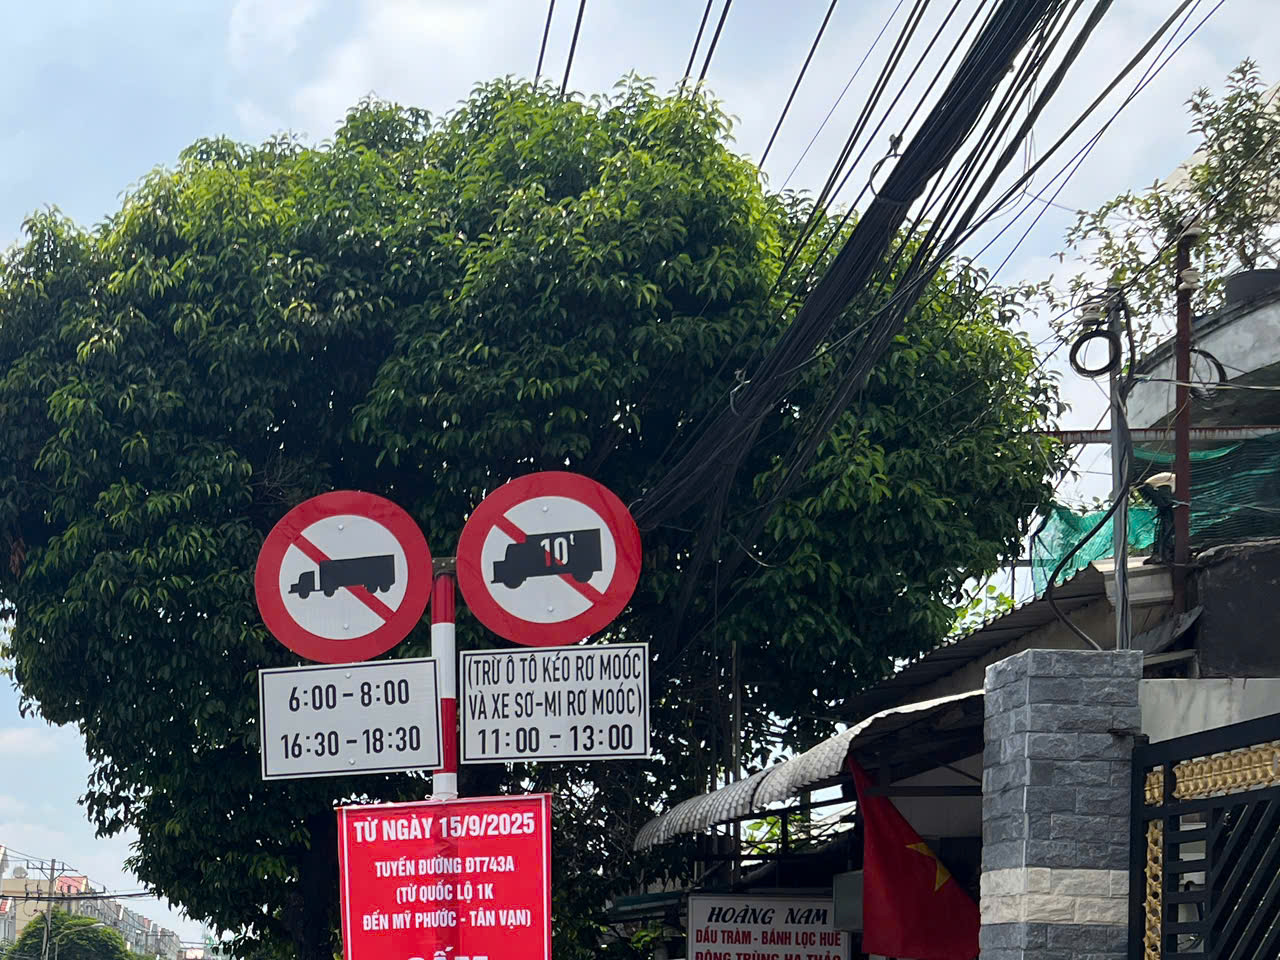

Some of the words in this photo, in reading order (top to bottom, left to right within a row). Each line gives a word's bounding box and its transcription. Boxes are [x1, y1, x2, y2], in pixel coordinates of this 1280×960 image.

[468, 656, 501, 689] (TRỪ
[506, 655, 515, 684] Ô
[520, 654, 537, 683] TÔ
[543, 651, 570, 682] KÉO
[576, 654, 596, 681] RƠ
[600, 649, 641, 680] MOÓC
[289, 684, 337, 712] 6:00
[360, 679, 410, 707] 8:00
[469, 690, 487, 720] VÀ
[492, 693, 509, 719] XE
[568, 689, 587, 716] RƠ
[592, 682, 642, 717] MOÓC)
[280, 730, 340, 759] 16:30
[363, 725, 420, 754] 18:30
[478, 727, 539, 755] 11:00
[570, 724, 632, 751] 13:00
[354, 817, 378, 842] TỪ
[382, 814, 433, 841] NGÀY
[439, 812, 534, 838] 15/9/2025
[375, 856, 415, 877] TUYẾN
[419, 854, 462, 875] ĐƯỜNG
[466, 856, 515, 873] ĐT743A
[396, 883, 417, 904] (TỪ
[420, 880, 453, 901] QUỐC
[457, 881, 472, 903] LỘ
[477, 884, 494, 899] 1K
[363, 909, 388, 930] ĐẾN
[392, 911, 411, 929] MỸ
[415, 908, 456, 928] PHƯỚC
[469, 907, 495, 927] TÂN
[499, 909, 531, 929] VẠN)
[707, 904, 775, 925] HOÀNG
[785, 908, 828, 925] NAM
[721, 927, 751, 945] TRÀM
[762, 928, 791, 946] BÁNH
[795, 931, 816, 949] LỌC
